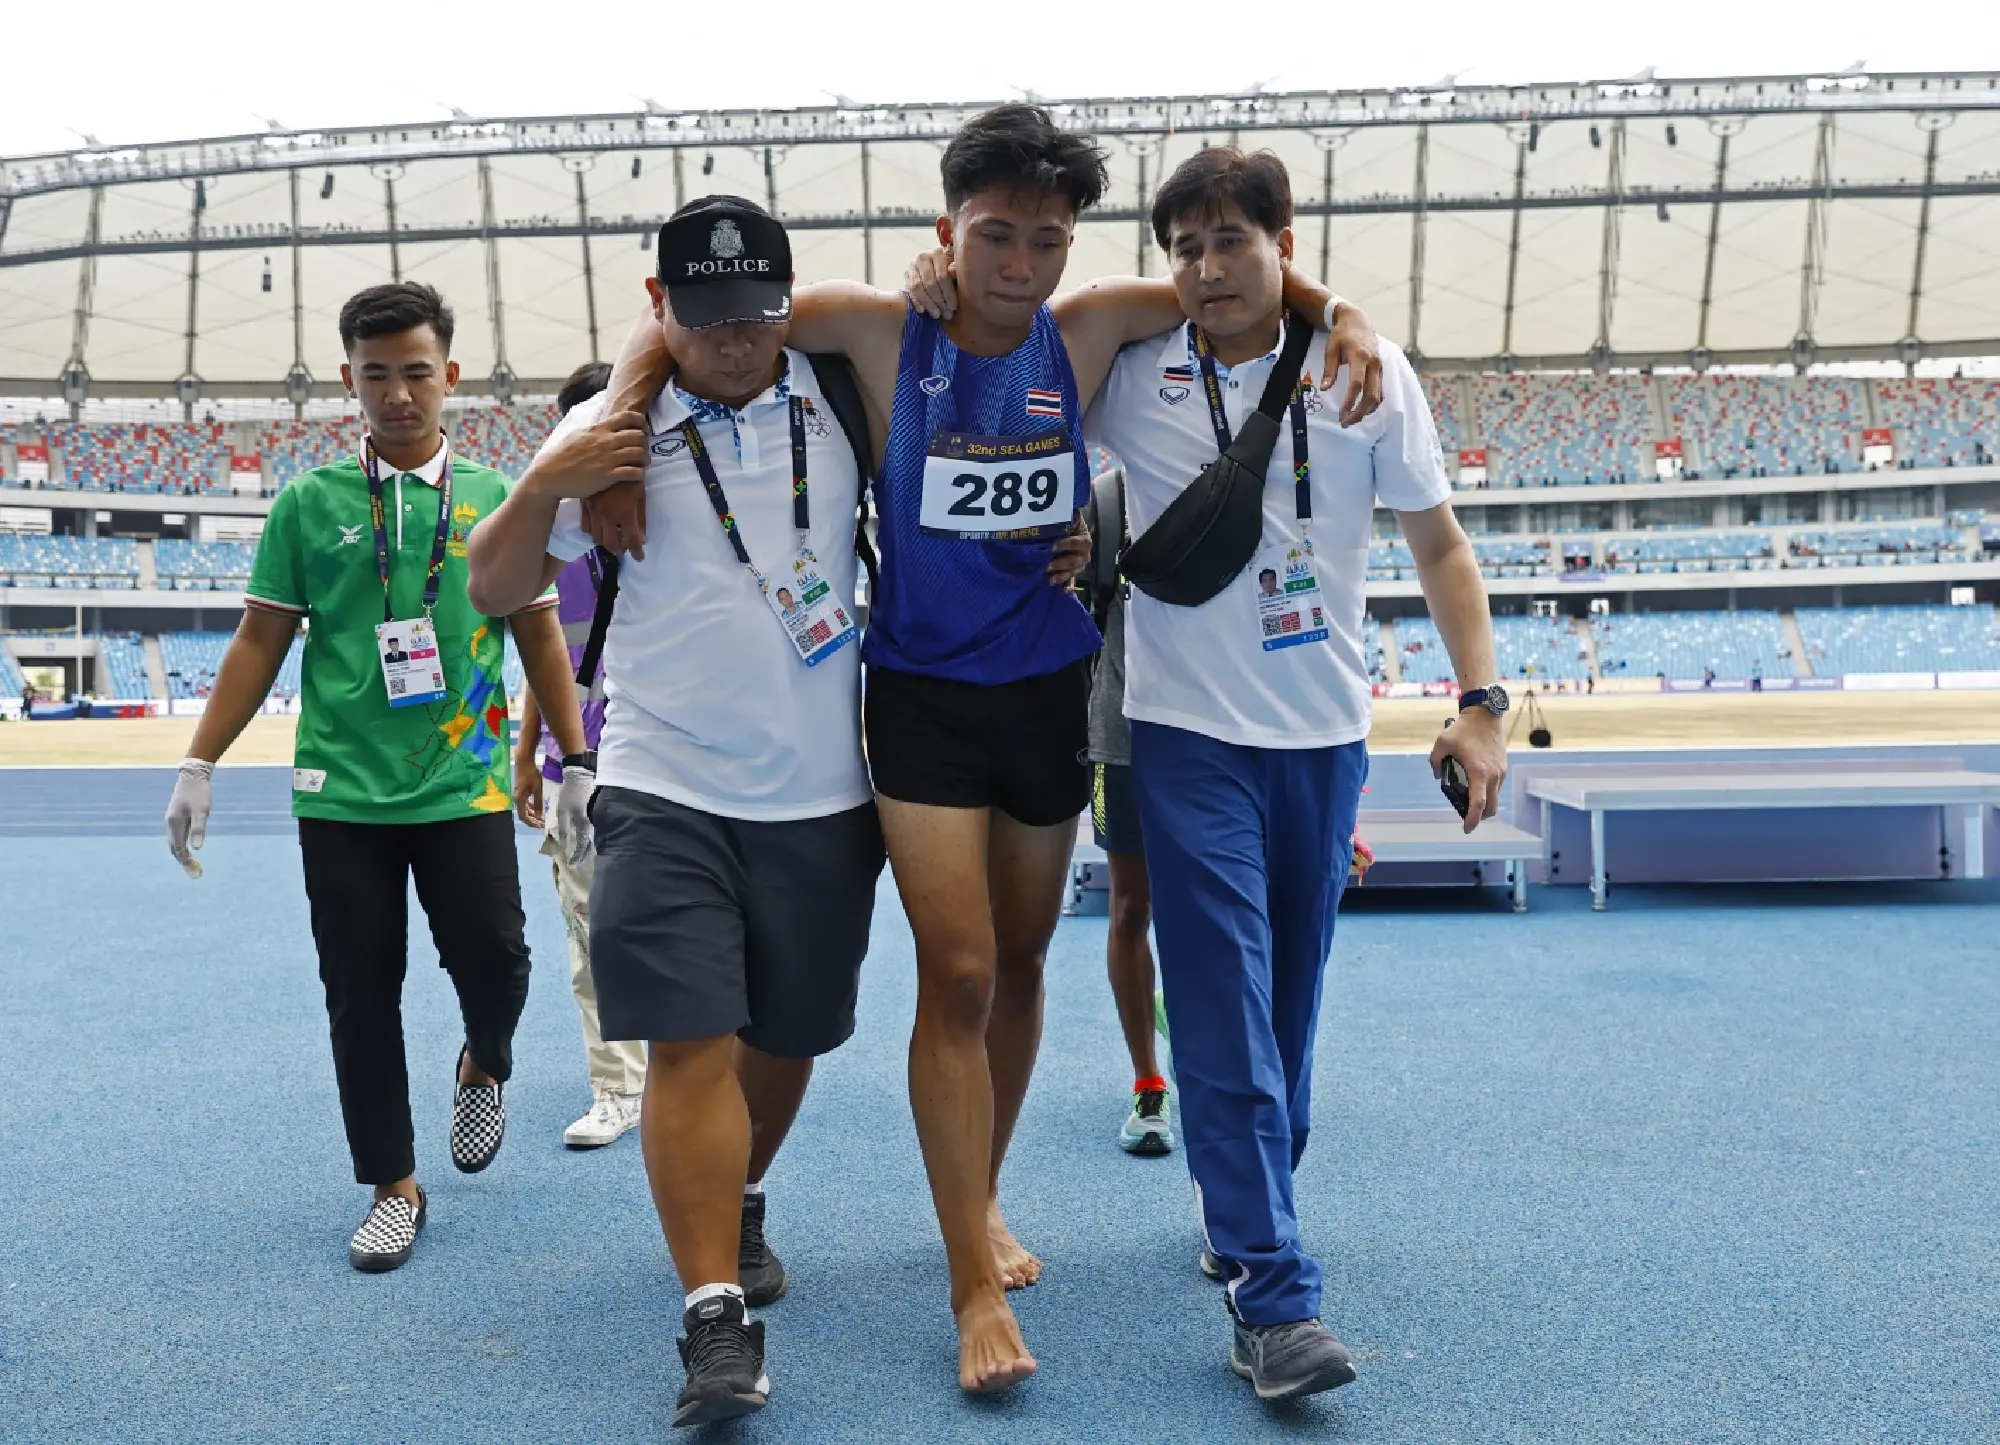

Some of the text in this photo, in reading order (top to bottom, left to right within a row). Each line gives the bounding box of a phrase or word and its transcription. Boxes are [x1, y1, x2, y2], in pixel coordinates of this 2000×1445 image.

[686, 259, 770, 276] POLICE
[967, 436, 1061, 457] 32nd SEA GAMES
[947, 468, 1059, 516] 289
[959, 531, 990, 540] SPORTS
